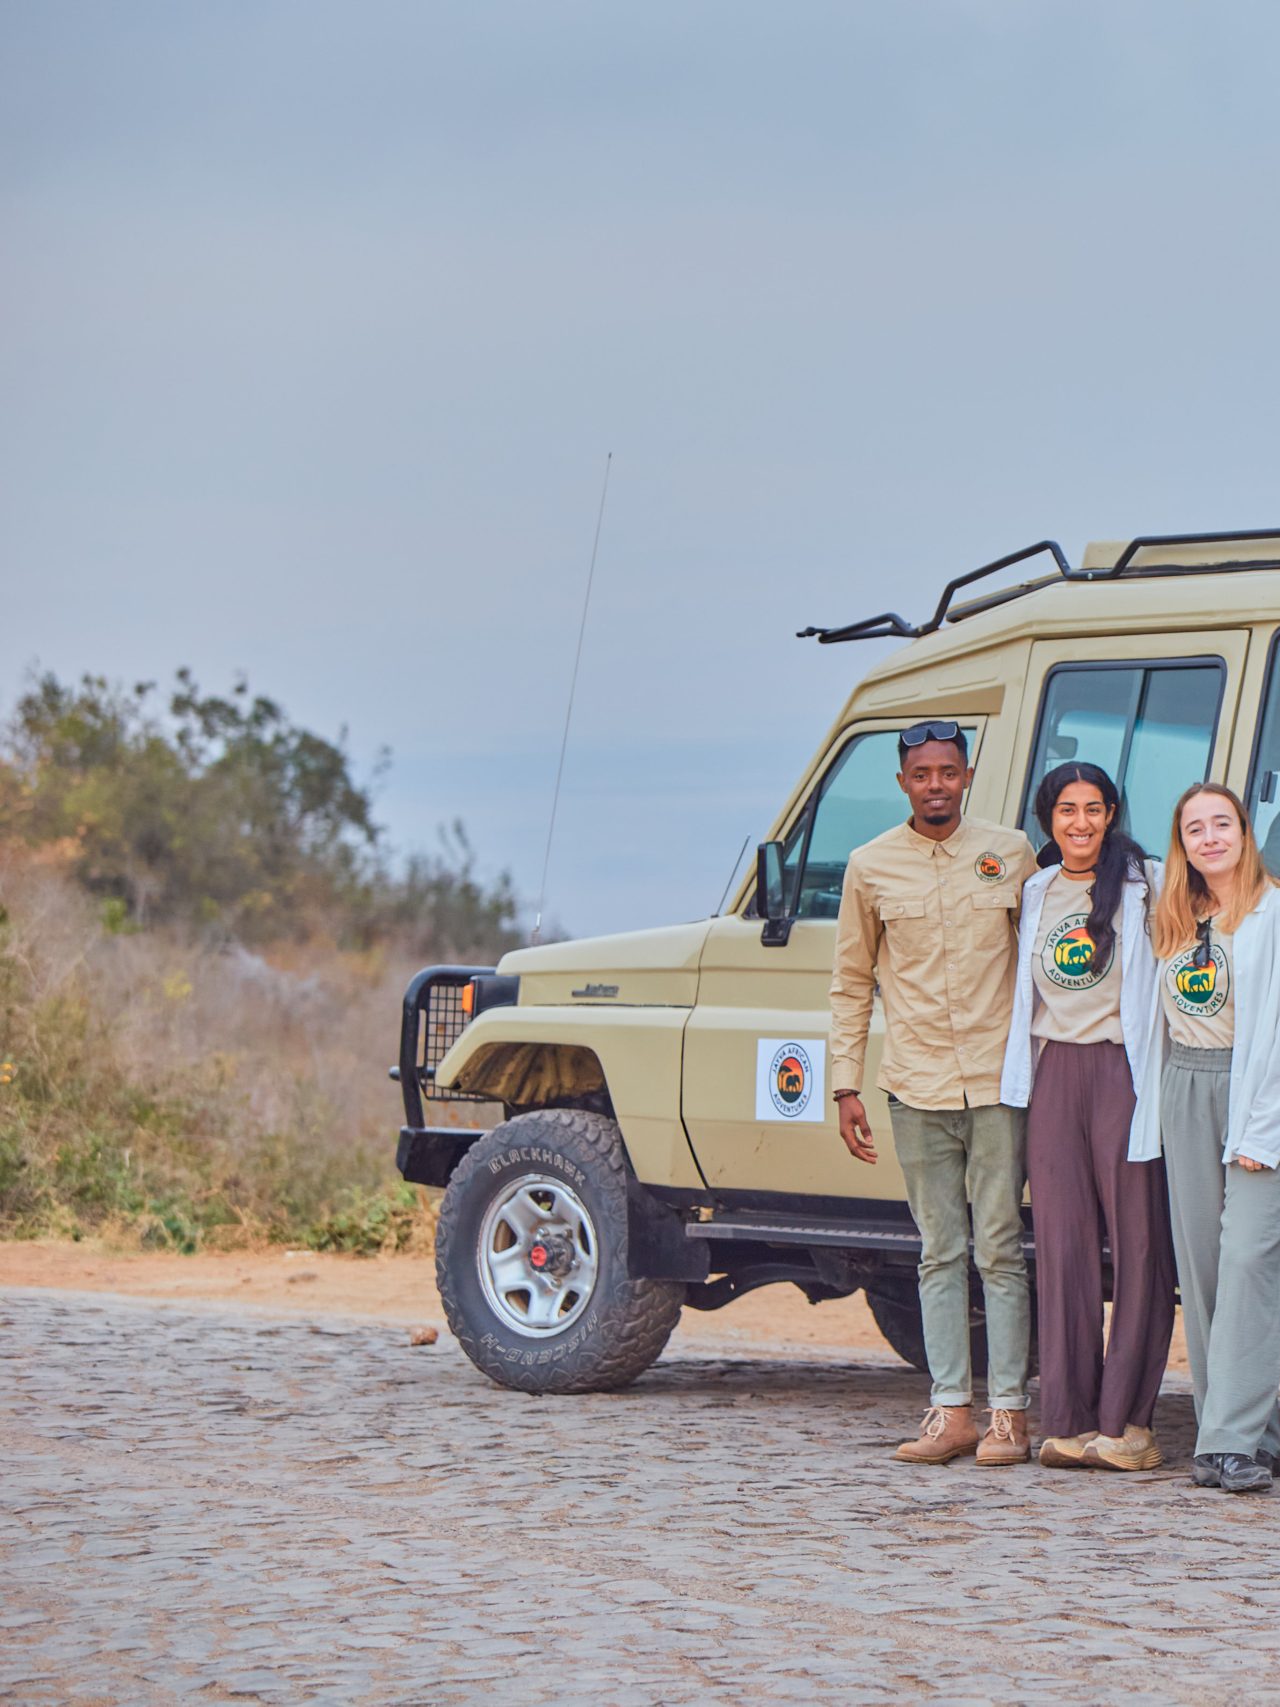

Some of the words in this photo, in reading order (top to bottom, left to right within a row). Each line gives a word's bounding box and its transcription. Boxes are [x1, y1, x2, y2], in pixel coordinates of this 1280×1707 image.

[1047, 922, 1071, 949] JAYVA
[1049, 968, 1101, 986] ADVENTUR
[488, 1147, 586, 1187] BLACKHAWK
